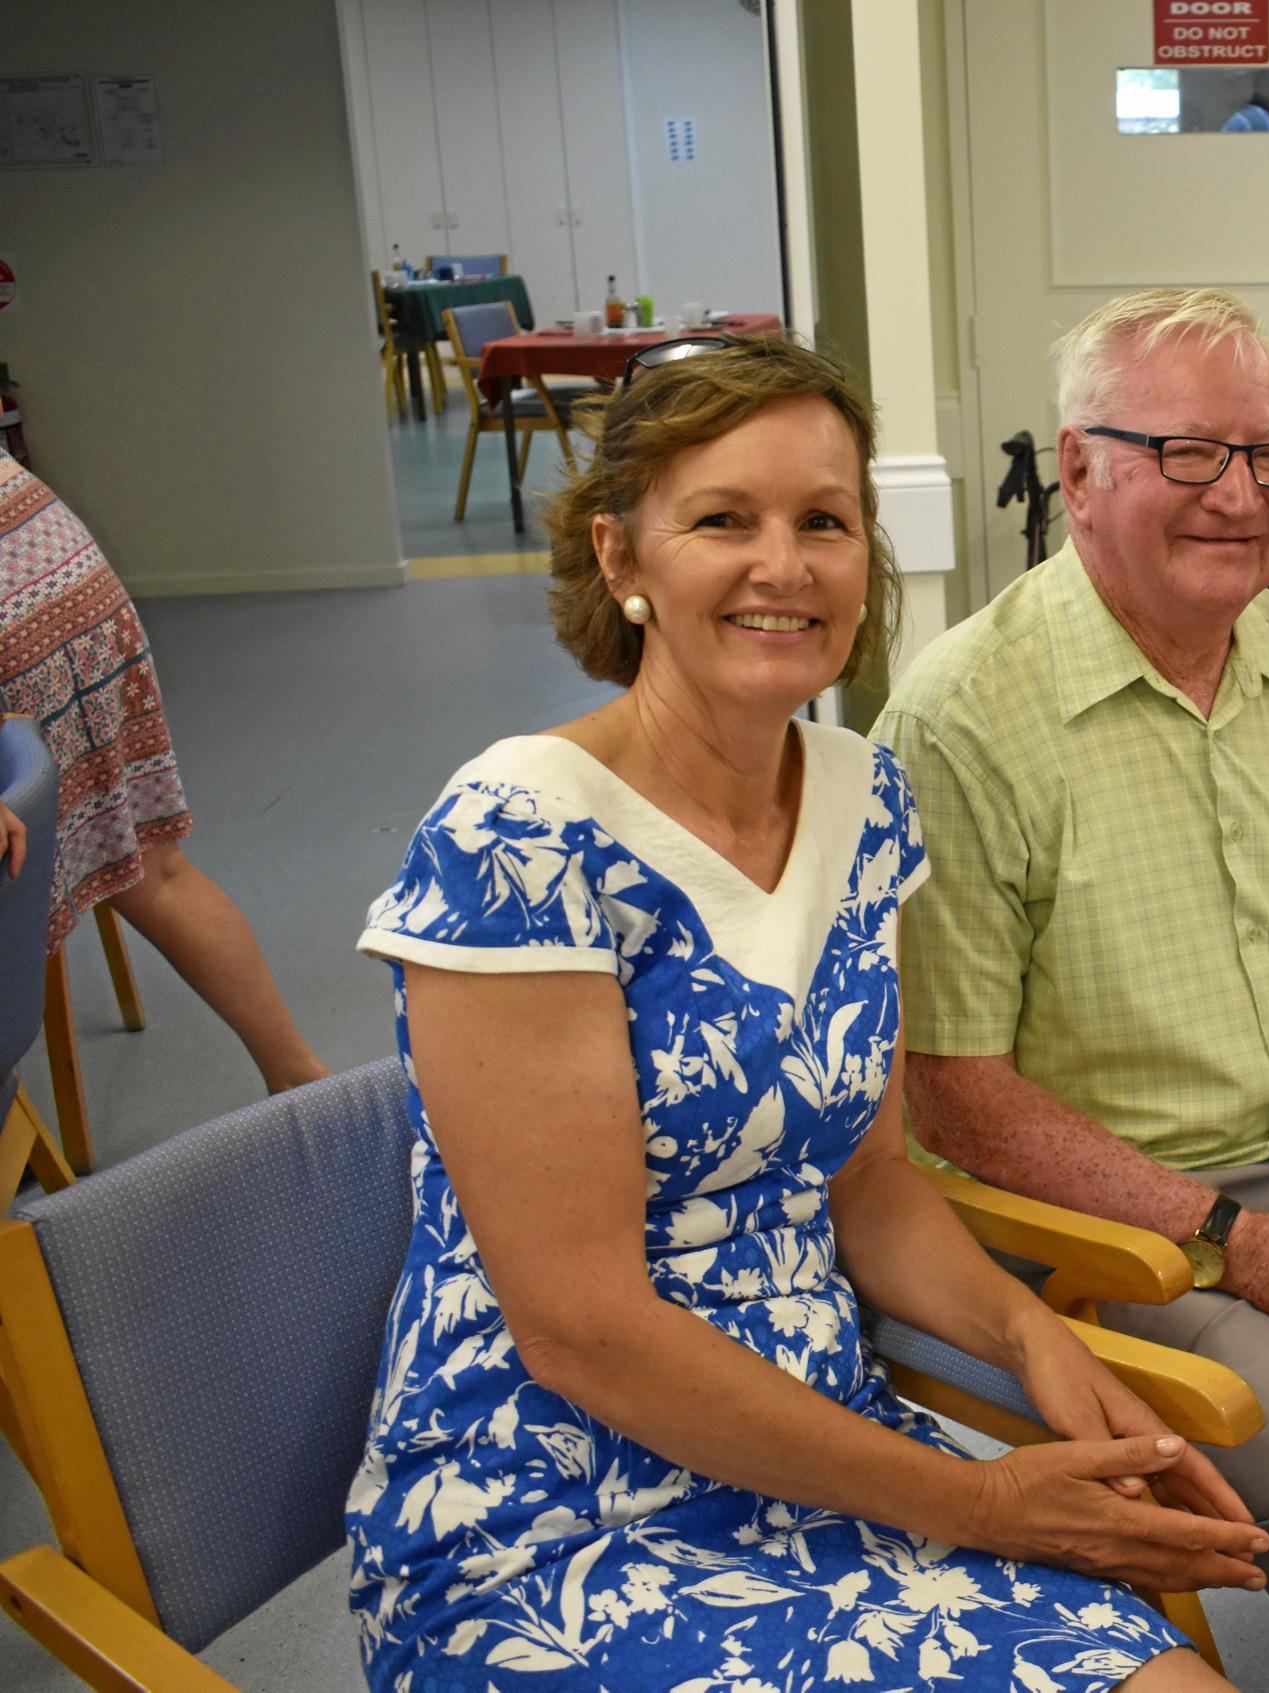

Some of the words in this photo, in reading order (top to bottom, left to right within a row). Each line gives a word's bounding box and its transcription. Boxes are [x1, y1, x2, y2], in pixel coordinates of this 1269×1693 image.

[1169, 2, 1252, 15] DOOR
[1173, 27, 1203, 40] DO
[1208, 27, 1250, 40] NOT
[1158, 45, 1266, 58] OBSTRUCT
